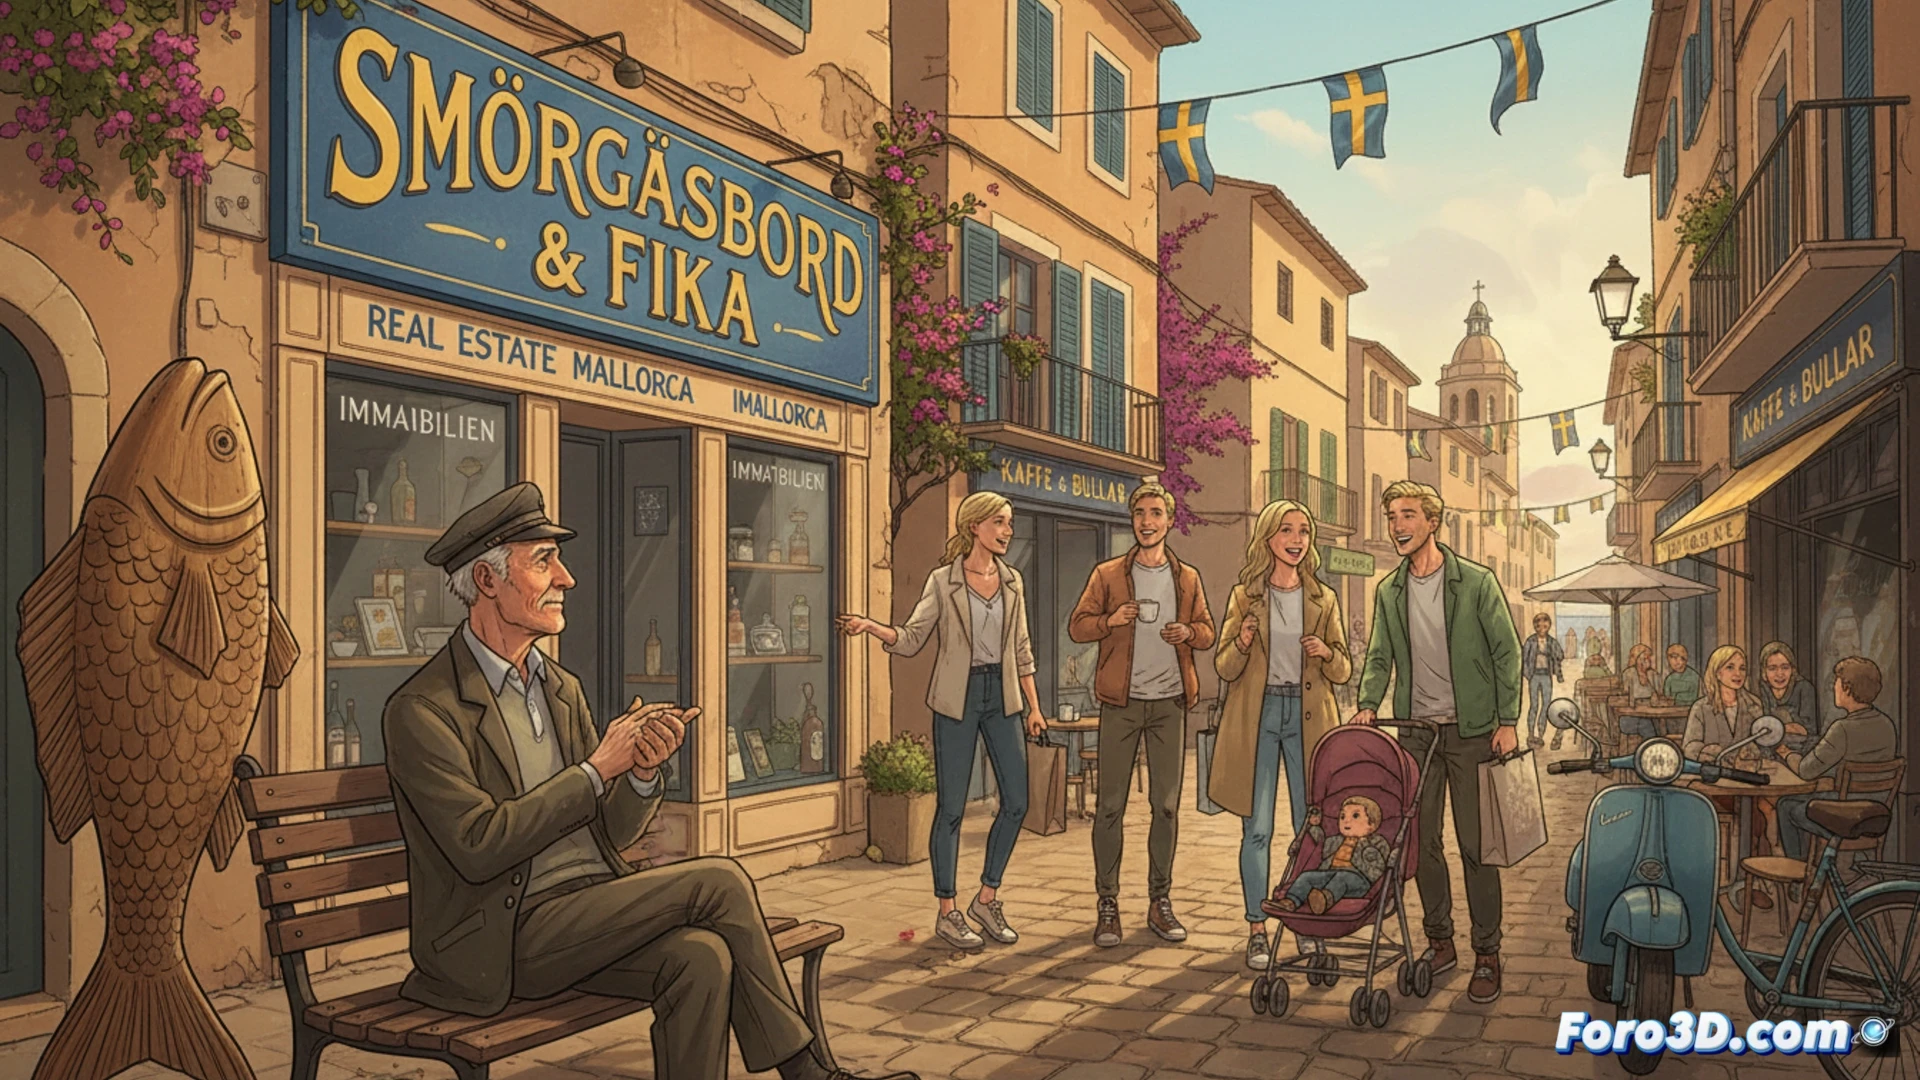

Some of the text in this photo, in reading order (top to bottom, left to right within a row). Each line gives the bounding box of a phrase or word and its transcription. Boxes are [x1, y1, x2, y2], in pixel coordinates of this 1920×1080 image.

[326, 26, 866, 337] SMÖRGÄSBORD
[533, 221, 760, 347] & FIKA
[368, 303, 828, 434] REAL ESTATE MALLORCA IMALLORCA
[1801, 323, 1875, 404] BULLAR
[340, 395, 495, 443] IMMAIBILIEN
[1001, 457, 1053, 492] KAFFE
